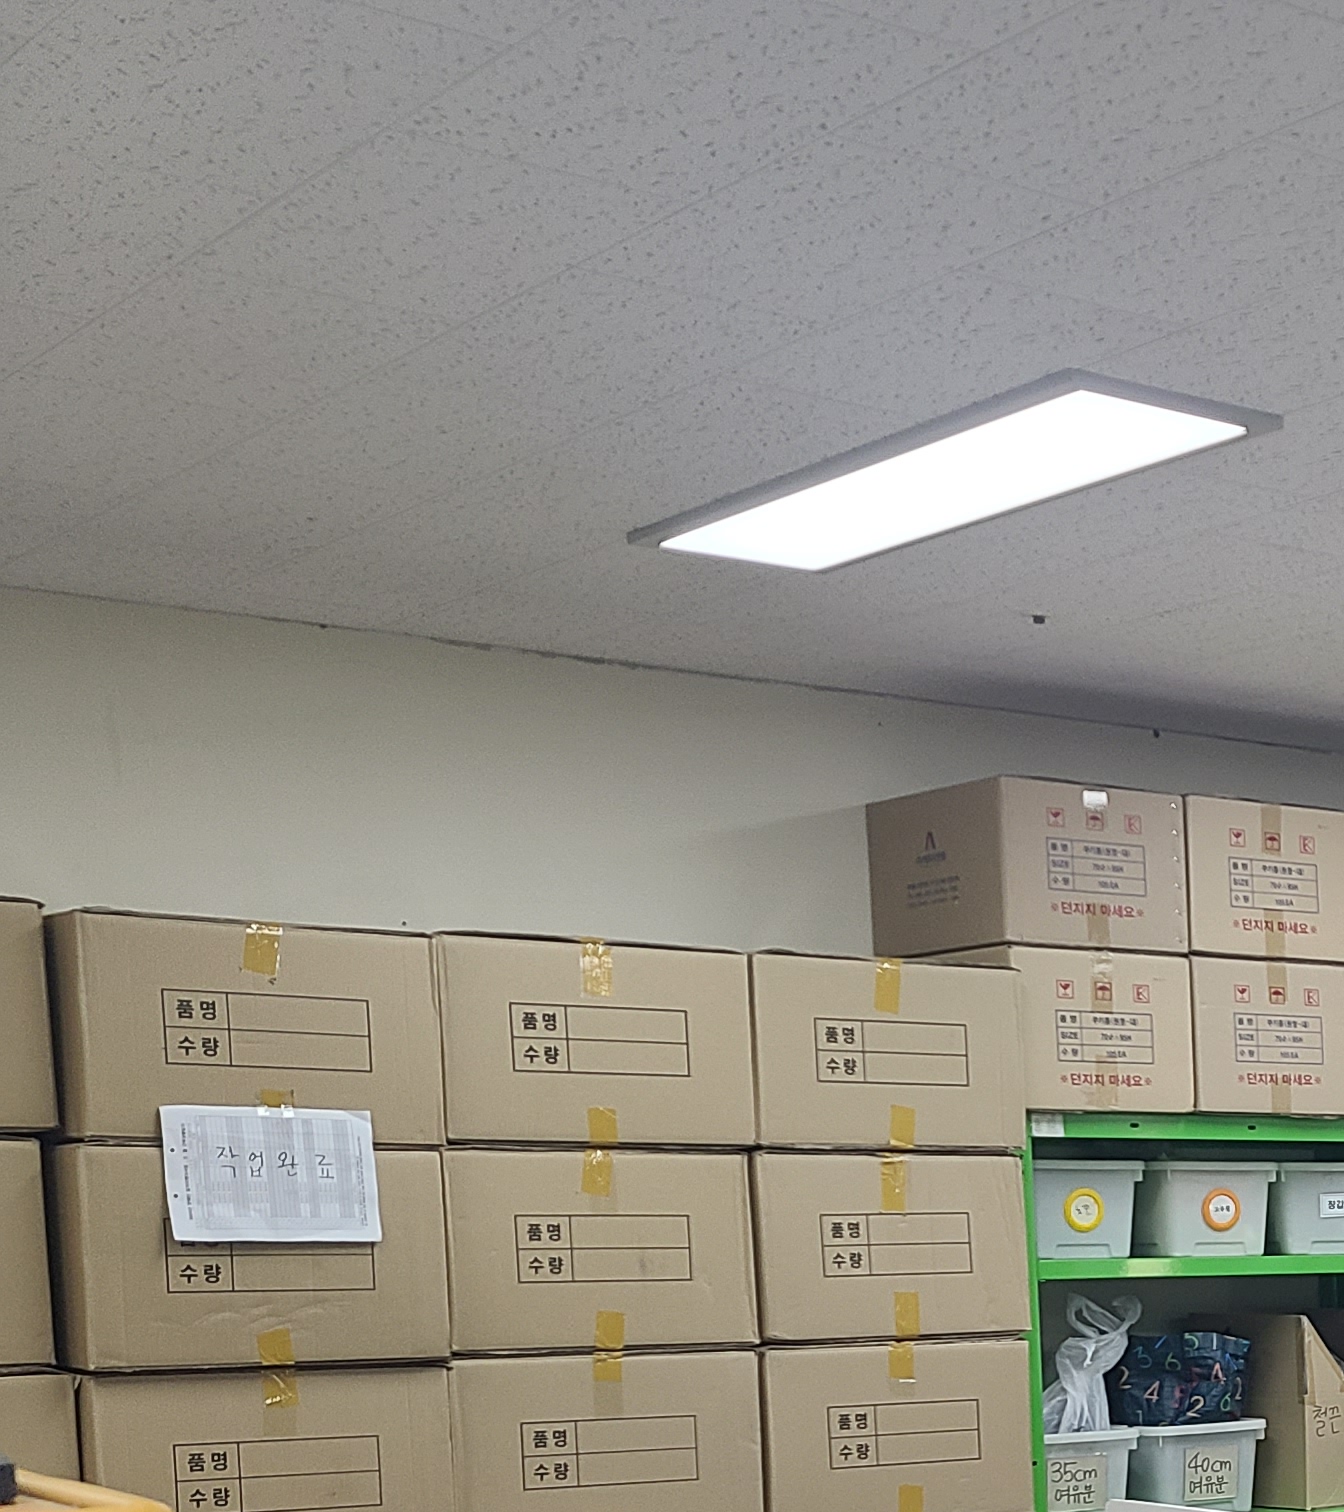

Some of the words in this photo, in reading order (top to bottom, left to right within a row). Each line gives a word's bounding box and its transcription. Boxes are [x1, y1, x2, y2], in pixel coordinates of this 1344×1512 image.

[1143, 1380, 1160, 1403] 4
[1186, 1395, 1204, 1418] 2
[1050, 1461, 1098, 1483] 35cm
[1188, 1452, 1232, 1474] 40cm
[1055, 1484, 1096, 1504] 여유분
[1189, 1475, 1228, 1495] 여유분
